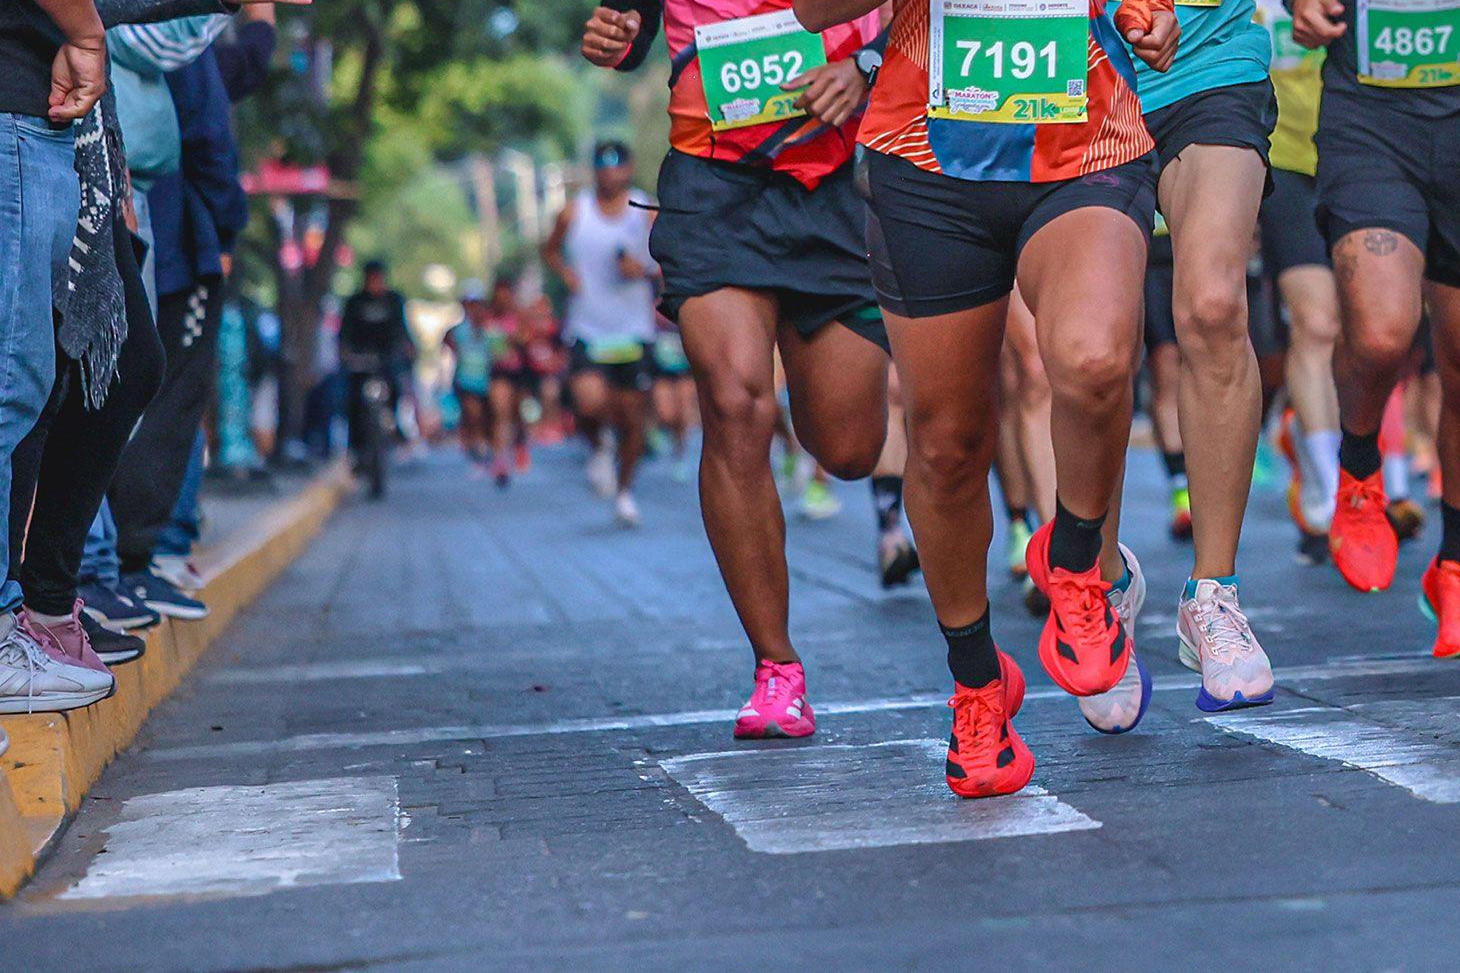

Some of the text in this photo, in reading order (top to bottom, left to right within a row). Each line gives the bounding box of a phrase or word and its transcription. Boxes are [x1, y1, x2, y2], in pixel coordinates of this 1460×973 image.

[1374, 25, 1453, 55] 4867
[721, 50, 803, 93] 6952
[956, 40, 1057, 79] 7191
[1013, 98, 1056, 119] 21k
